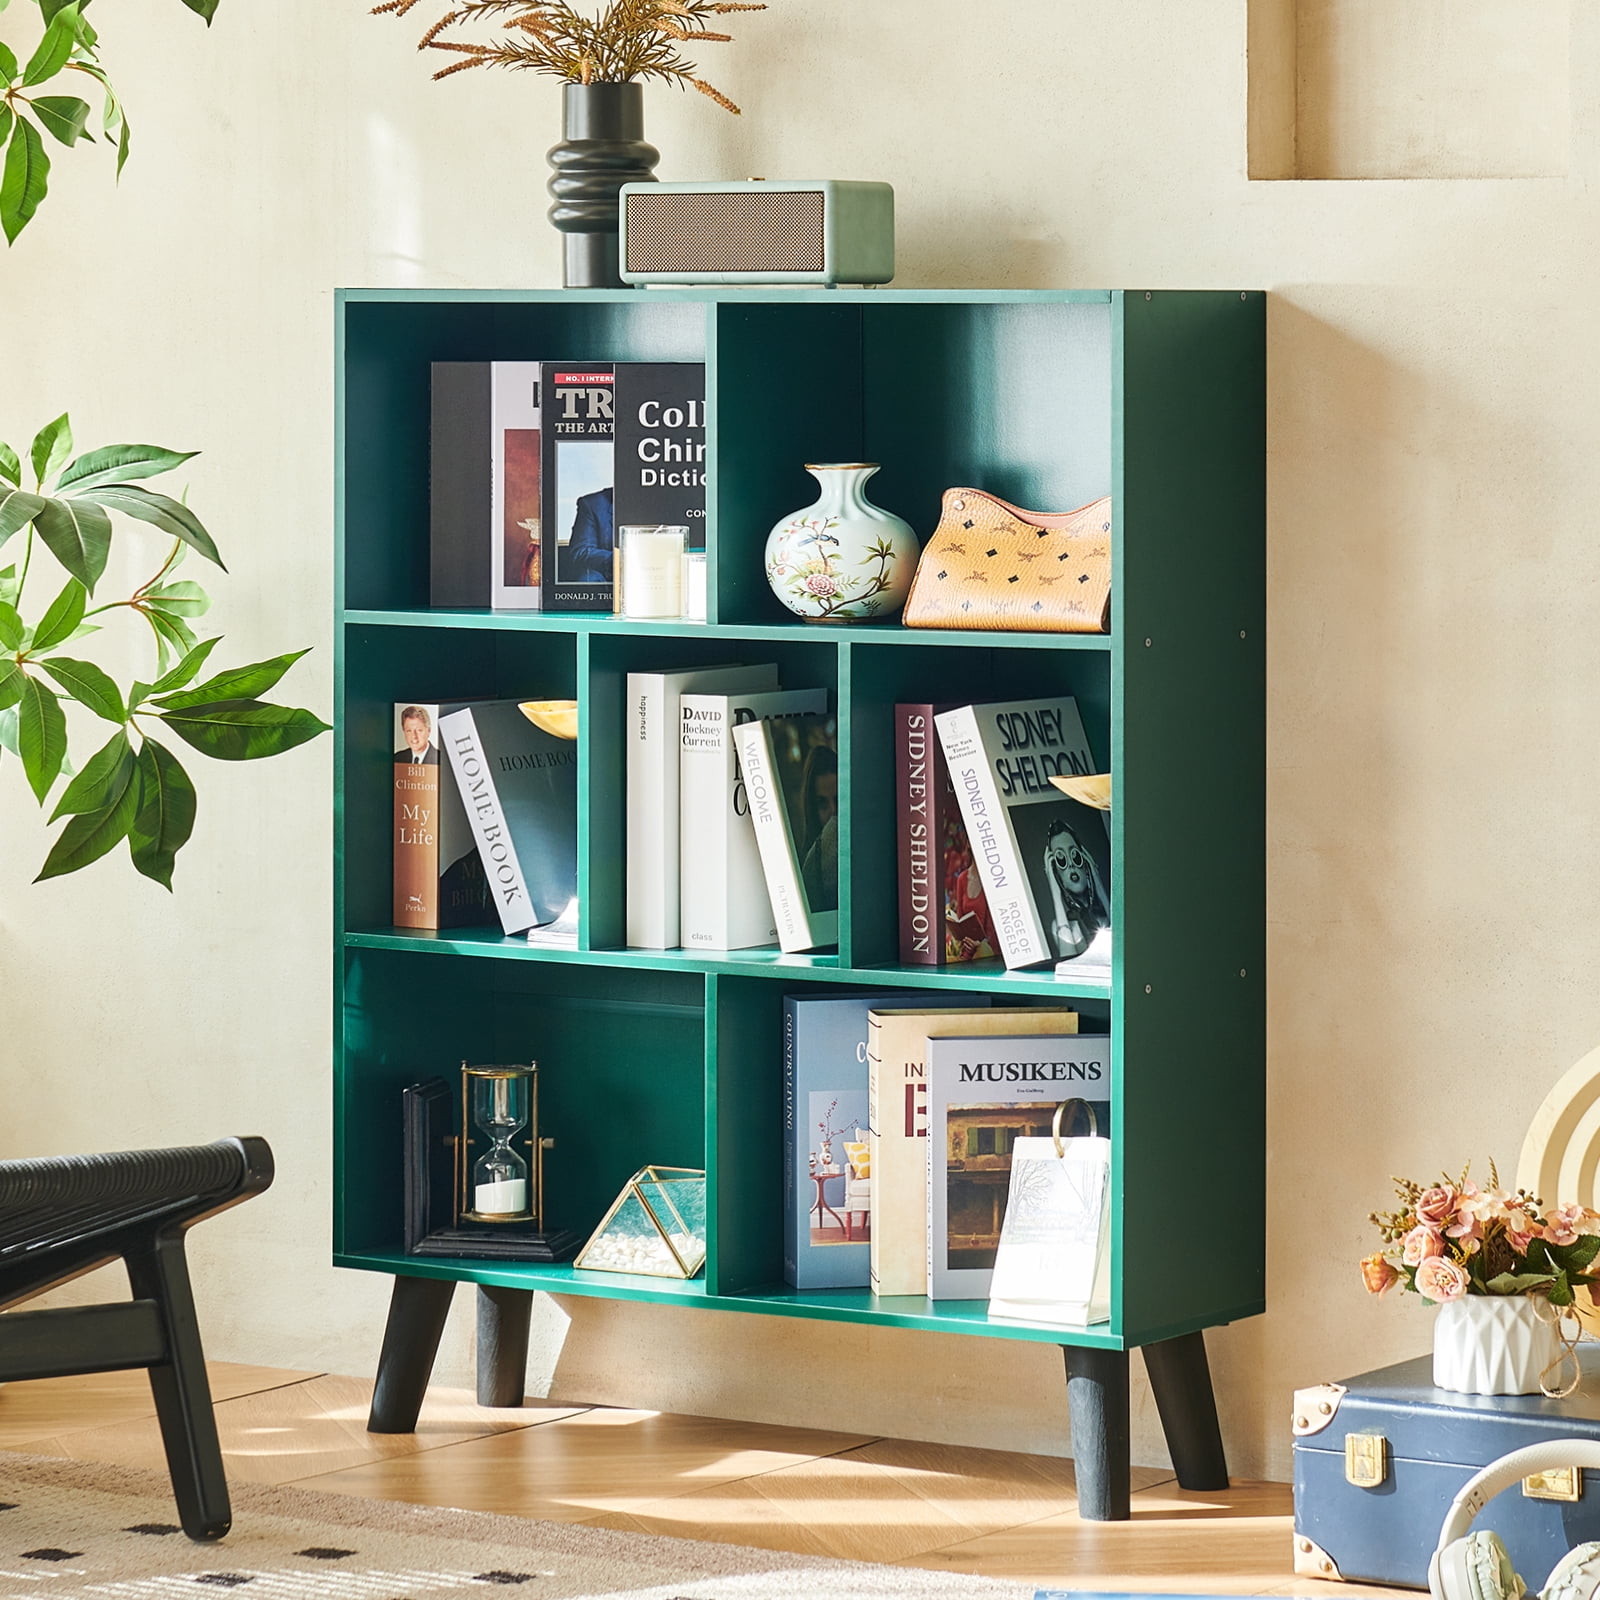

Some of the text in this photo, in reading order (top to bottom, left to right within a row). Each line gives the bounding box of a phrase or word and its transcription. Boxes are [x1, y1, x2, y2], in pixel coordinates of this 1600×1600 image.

[555, 388, 614, 418] TR
[555, 422, 585, 433] THE
[554, 592, 589, 600] DONALD
[638, 695, 648, 741] happiness
[683, 707, 722, 721] DAVID
[682, 723, 722, 737] Hockney
[996, 707, 1066, 752] SIDNEY
[682, 735, 721, 747] Current
[407, 766, 426, 778] Bill
[500, 753, 546, 771] HOME
[395, 779, 438, 791] Clintion
[744, 741, 773, 824] WELCOME
[733, 783, 751, 816] C
[402, 803, 431, 826] My
[454, 734, 495, 821] HOME
[483, 823, 522, 906] BOOK
[399, 827, 434, 846] Life
[908, 714, 929, 955] SIDNEY SHELDON
[961, 768, 1009, 889] SIDNEY SHELDON
[691, 932, 713, 941] class
[998, 908, 1021, 955] ANGELS
[1018, 938, 1032, 954] OF
[856, 1041, 869, 1063] C
[905, 1063, 926, 1077] IN
[958, 1061, 1102, 1083] MUSIKENS
